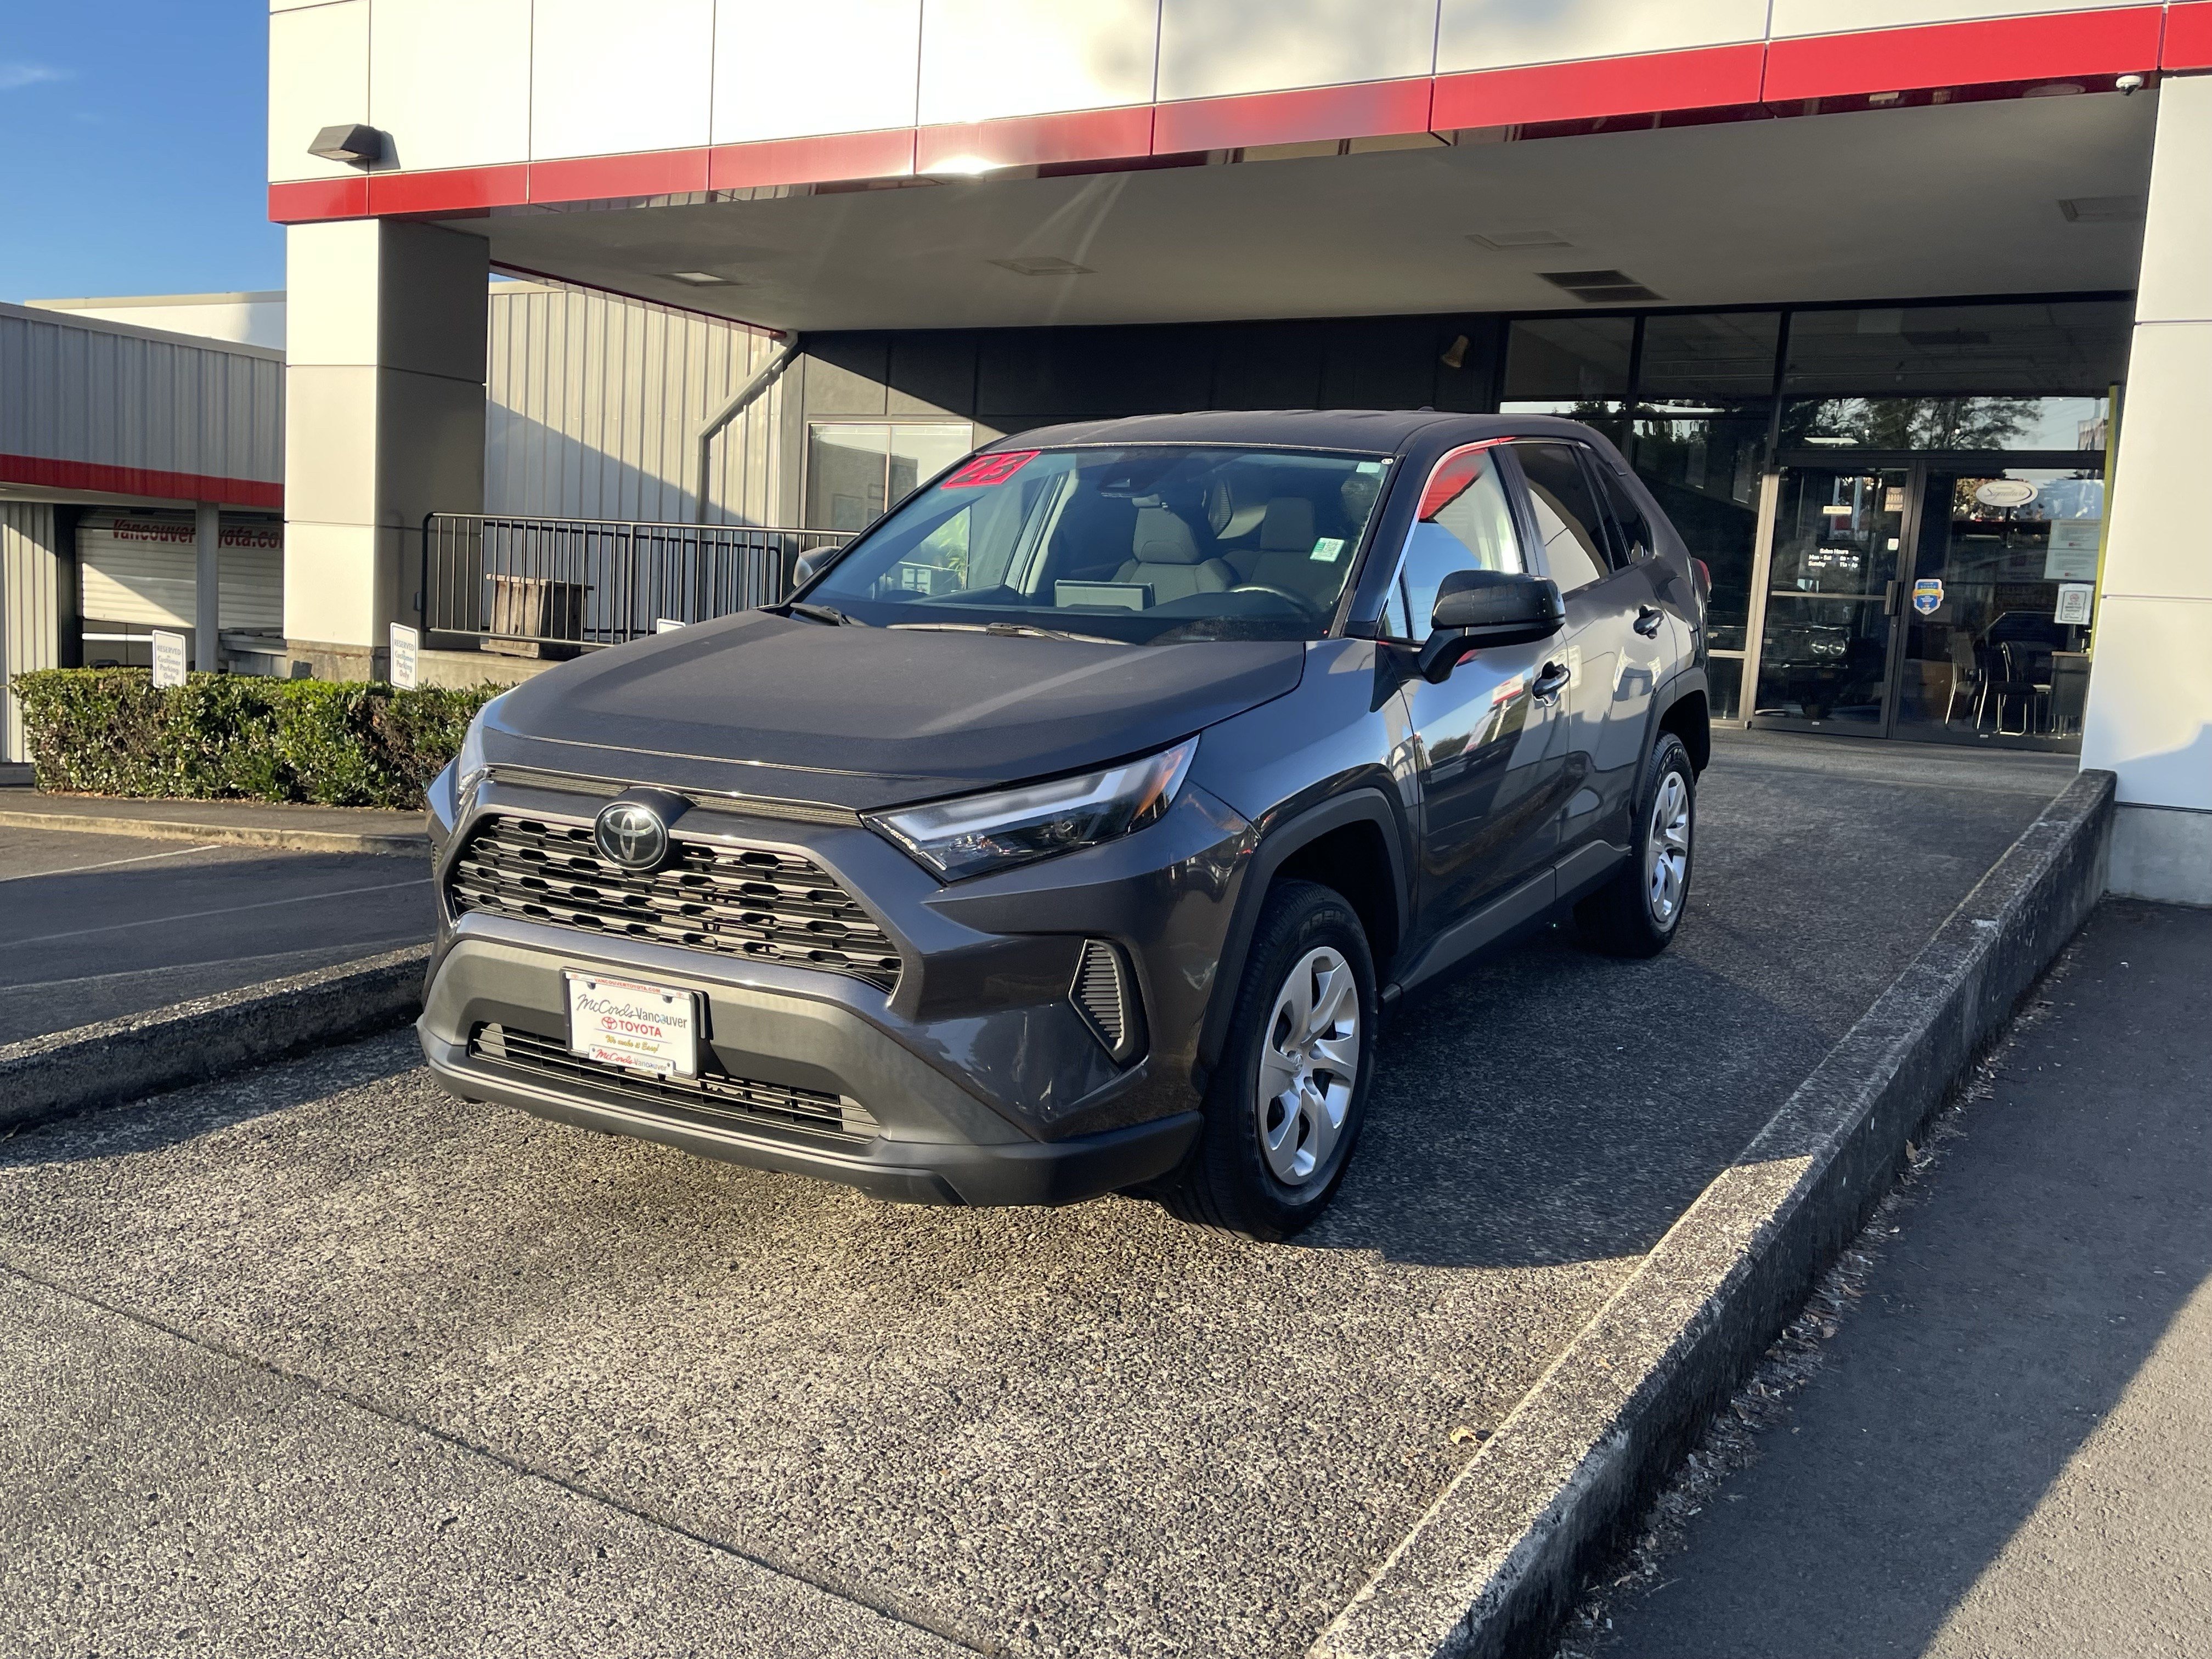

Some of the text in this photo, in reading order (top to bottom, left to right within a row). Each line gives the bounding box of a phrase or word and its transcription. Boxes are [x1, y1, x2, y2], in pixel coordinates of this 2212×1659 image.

[950, 455, 1031, 484] 23
[157, 645, 182, 656] RESERVED
[394, 639, 414, 651] RESERVED
[157, 656, 180, 665] Customer
[394, 651, 414, 663] Customer
[160, 664, 179, 675] Parking
[396, 660, 413, 673] Parking
[163, 673, 175, 681] Only
[399, 669, 409, 680] Only
[594, 978, 661, 993] VANCOUVERTOYOTA.COM
[618, 1020, 663, 1038] TOYOTA
[605, 1034, 616, 1044] We
[617, 1039, 634, 1047] make
